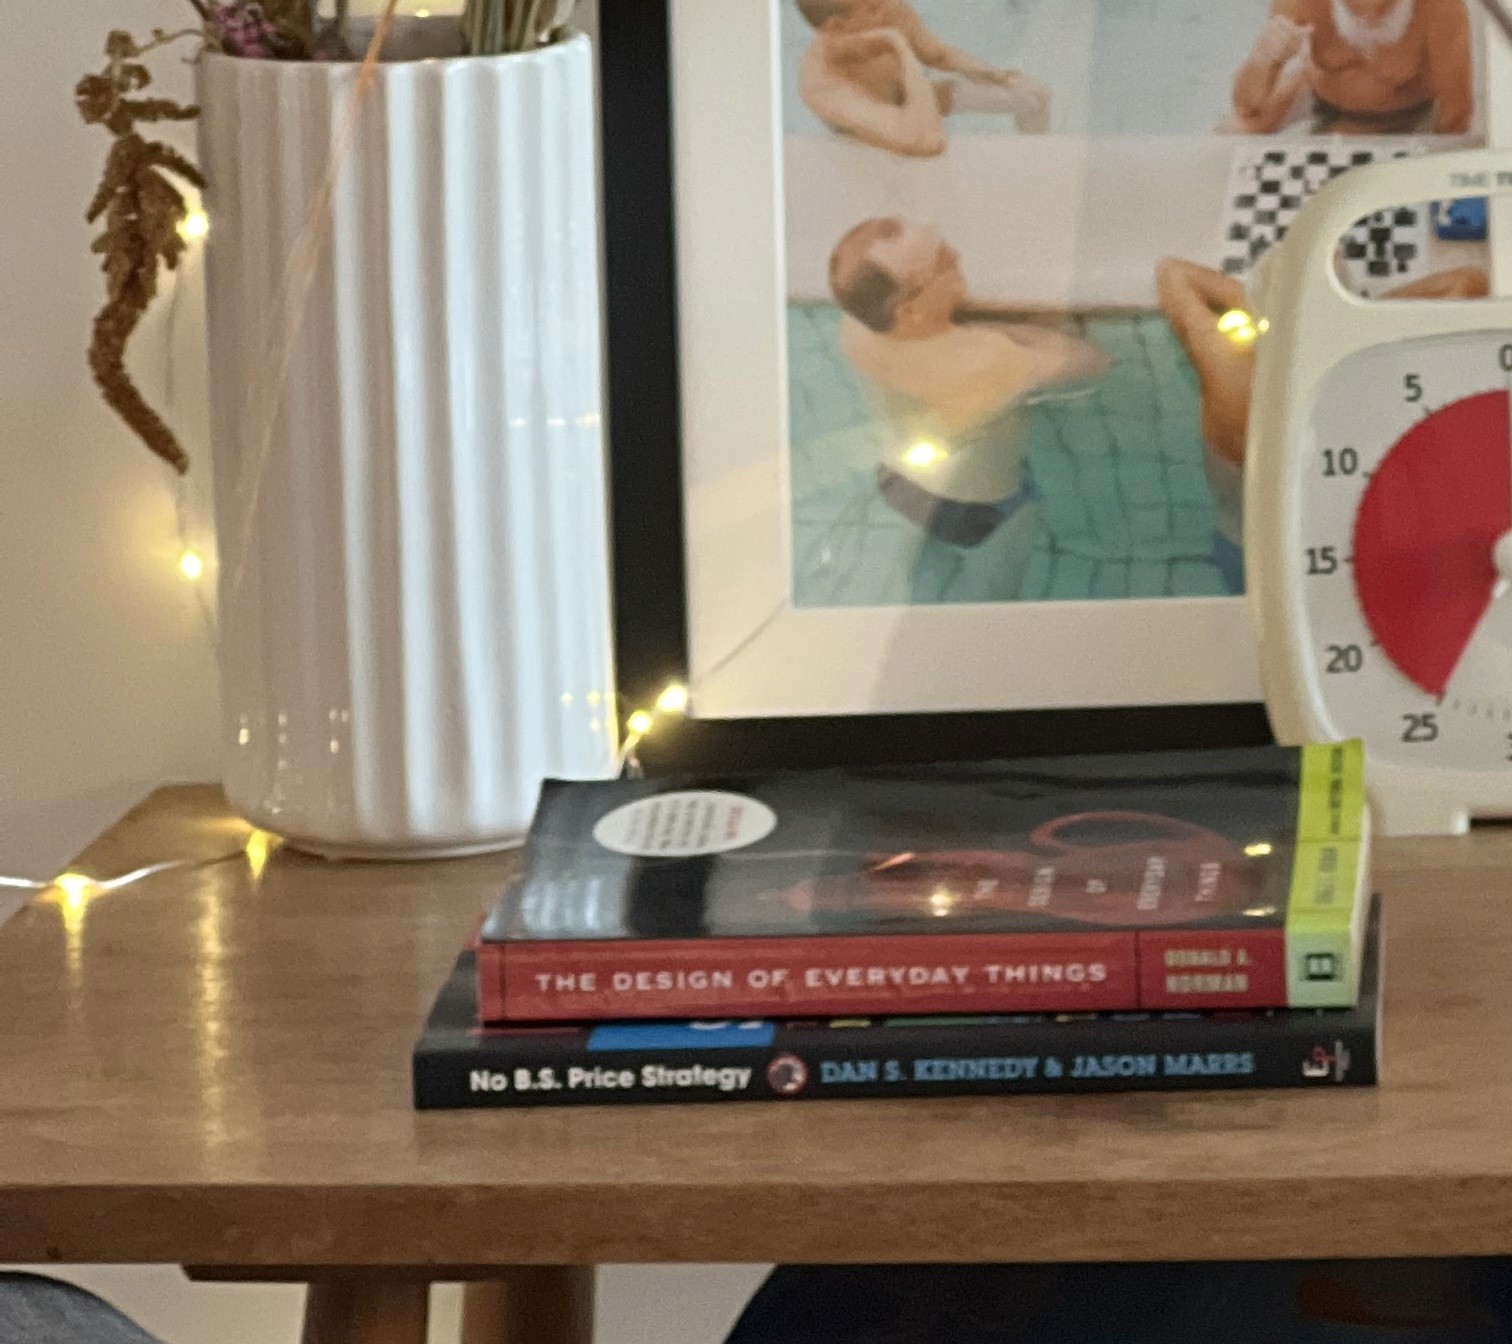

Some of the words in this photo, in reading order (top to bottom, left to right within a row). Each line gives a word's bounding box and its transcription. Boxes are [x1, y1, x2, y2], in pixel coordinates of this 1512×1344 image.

[1404, 374, 1423, 403] 5
[1322, 448, 1358, 477] 10
[1306, 546, 1338, 575] 15
[1325, 644, 1362, 673] 20
[1401, 714, 1439, 743] 25
[535, 972, 597, 994] THE
[612, 968, 733, 992] DESIGN
[746, 967, 790, 989] OF
[804, 965, 971, 989] EVERYDAY
[984, 962, 1108, 985] THINGS
[1165, 973, 1249, 994] NORMAN
[469, 1069, 508, 1092] No
[513, 1067, 562, 1091] B.S.
[567, 1066, 635, 1090] Price
[641, 1064, 752, 1091] Strategy
[820, 1060, 877, 1084] DAN
[884, 1060, 907, 1083] S.
[912, 1057, 1039, 1082] KENNEDY
[1043, 1057, 1064, 1078] &
[1070, 1055, 1157, 1078] JASON
[1163, 1052, 1254, 1076] MARRS
